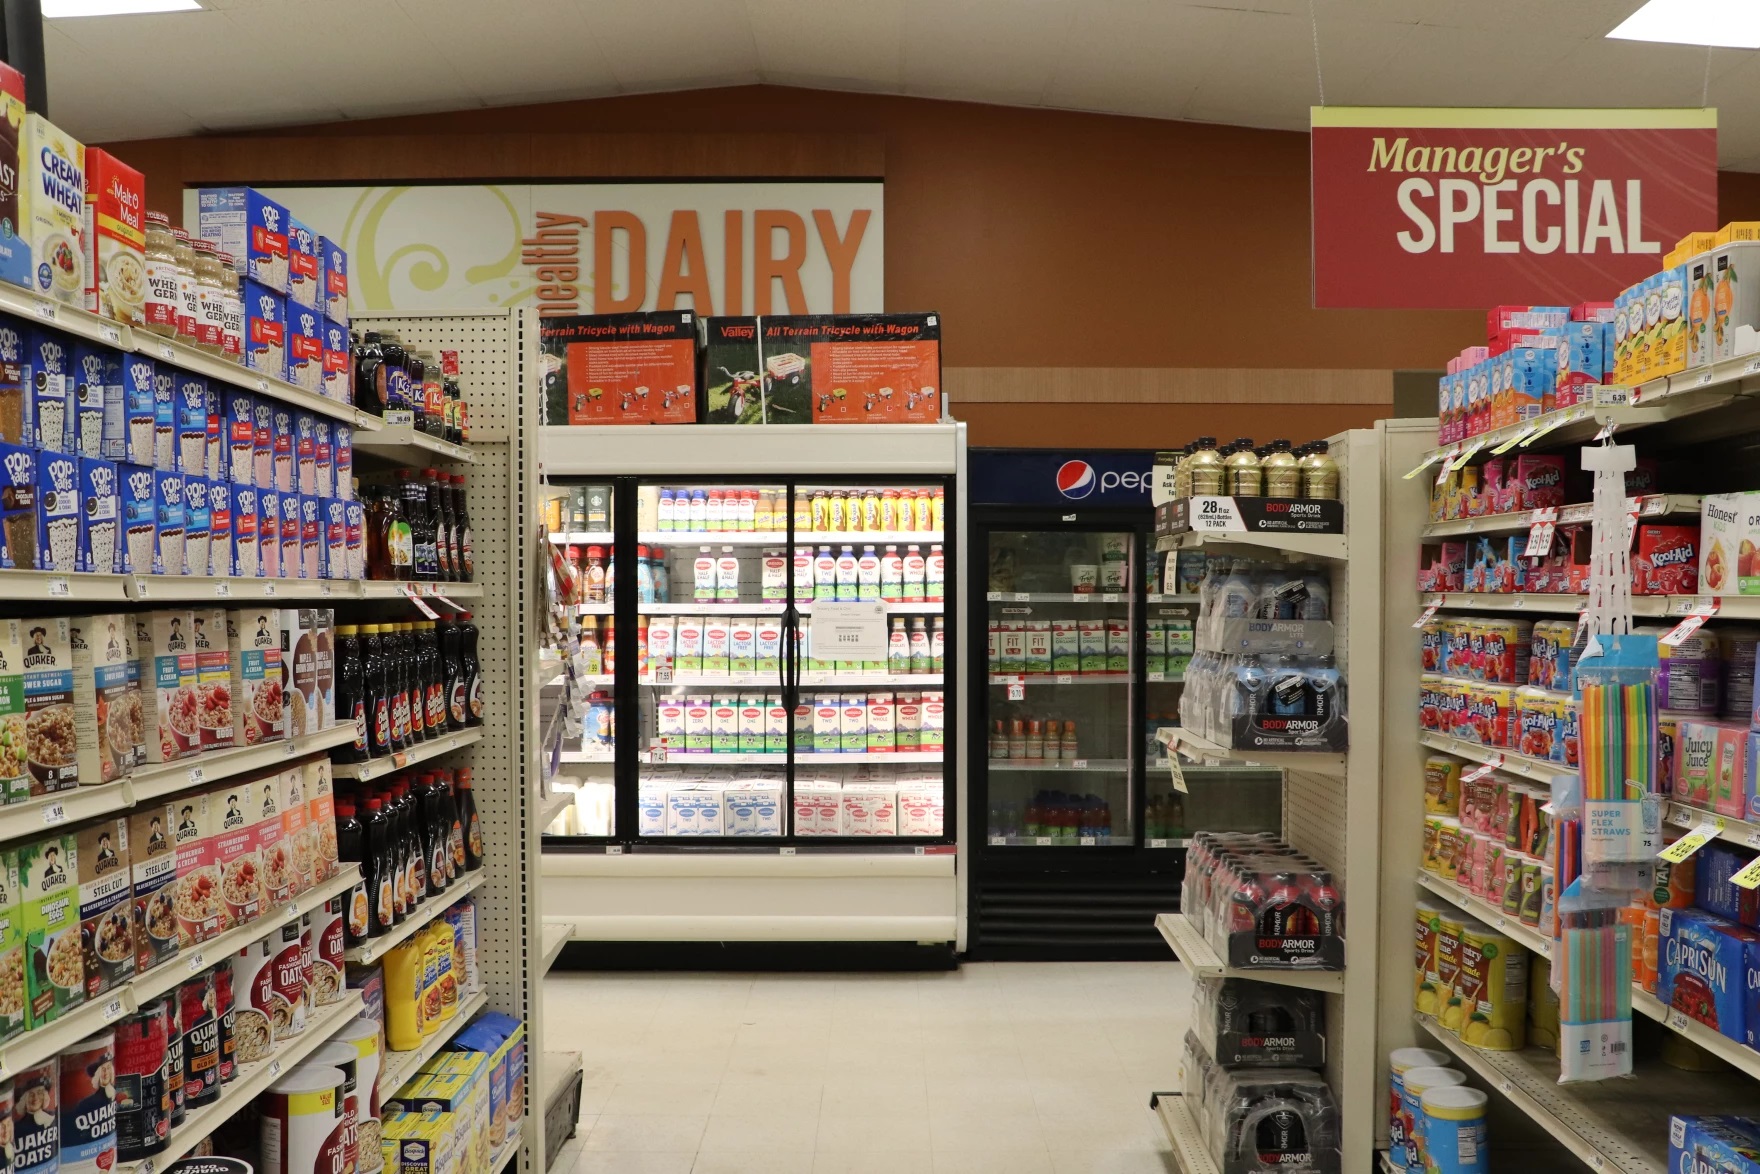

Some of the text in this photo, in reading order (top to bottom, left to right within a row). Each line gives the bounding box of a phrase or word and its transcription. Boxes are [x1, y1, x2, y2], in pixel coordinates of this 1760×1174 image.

[1367, 137, 1585, 183] Manager's
[41, 146, 82, 192] CREAM
[42, 172, 82, 215] WHEAT
[114, 180, 132, 206] Malt
[120, 203, 139, 229] Meal
[1396, 177, 1661, 254] SPECIAL
[594, 209, 872, 316] DAIRY
[541, 323, 676, 337] Terrain Tricycle with Wagon
[721, 326, 755, 339] Valley
[766, 324, 919, 336] All Terrain Tricycle with Wagon
[1612, 394, 1627, 402] 6.39
[1100, 471, 1153, 493] pep
[1525, 471, 1560, 489] Kool-Aid
[1202, 500, 1218, 514] 28
[1266, 503, 1321, 514] BODYARMOR
[1707, 503, 1737, 523] Honest
[1206, 520, 1227, 528] 12 PACK
[1649, 544, 1695, 568] Kool-Aid
[1249, 623, 1305, 632] BODYARMOR
[168, 640, 187, 653] QUAKER
[255, 637, 273, 647] QUAKER
[1007, 637, 1019, 647] FIT
[1032, 637, 1044, 647] FIT
[106, 648, 122, 661] QUAKER
[24, 655, 58, 669] QUAKER
[162, 666, 174, 674] FRUIT
[42, 678, 63, 688] SUGAR
[1262, 720, 1319, 730] BODYARMOR
[1522, 713, 1557, 729] Kool-Aid
[1685, 737, 1713, 758] Juicy
[1686, 753, 1709, 767] Juice
[48, 770, 53, 779] 8
[262, 805, 276, 818] QUAKER
[1591, 810, 1621, 818] SUPER
[223, 816, 244, 830] QUAKER
[259, 823, 281, 836] STRAWBERRIES
[1591, 819, 1613, 827] FLEX
[176, 828, 198, 842] QUAKER
[1591, 828, 1631, 836] STRAWS
[147, 840, 168, 856] QUAKER
[218, 834, 250, 849] STRAWBERRIES
[229, 843, 244, 854] CREAM
[95, 857, 119, 874] QUAKER
[182, 856, 198, 868] CREAM
[145, 865, 164, 877] STEEL
[1504, 864, 1514, 883] G
[42, 874, 67, 892] QUAKER
[93, 878, 123, 898] STEEL CUT
[136, 877, 158, 891] BLUEBERRIES
[1523, 872, 1535, 893] G
[41, 897, 70, 915] DINOSAUR
[82, 897, 109, 913] BLUEBERRIES
[48, 909, 65, 921] EGGS
[1258, 939, 1315, 949] BODYARMOR
[288, 955, 298, 963] OLD
[281, 965, 302, 986] OATS
[1747, 1029, 1754, 1042] 10
[1241, 1038, 1296, 1047] BODYARMOR
[320, 1092, 332, 1100] VALUE
[321, 1098, 330, 1106] SIZE
[421, 1104, 443, 1113] Bisquick
[75, 1100, 116, 1132] QUAKE
[91, 1118, 116, 1139] OATS
[1673, 1123, 1683, 1131] NOW
[15, 1145, 52, 1168] OATS
[80, 1147, 97, 1157] QUICK
[403, 1146, 426, 1155] Bisquick
[1257, 1153, 1312, 1163] BODYARMOR
